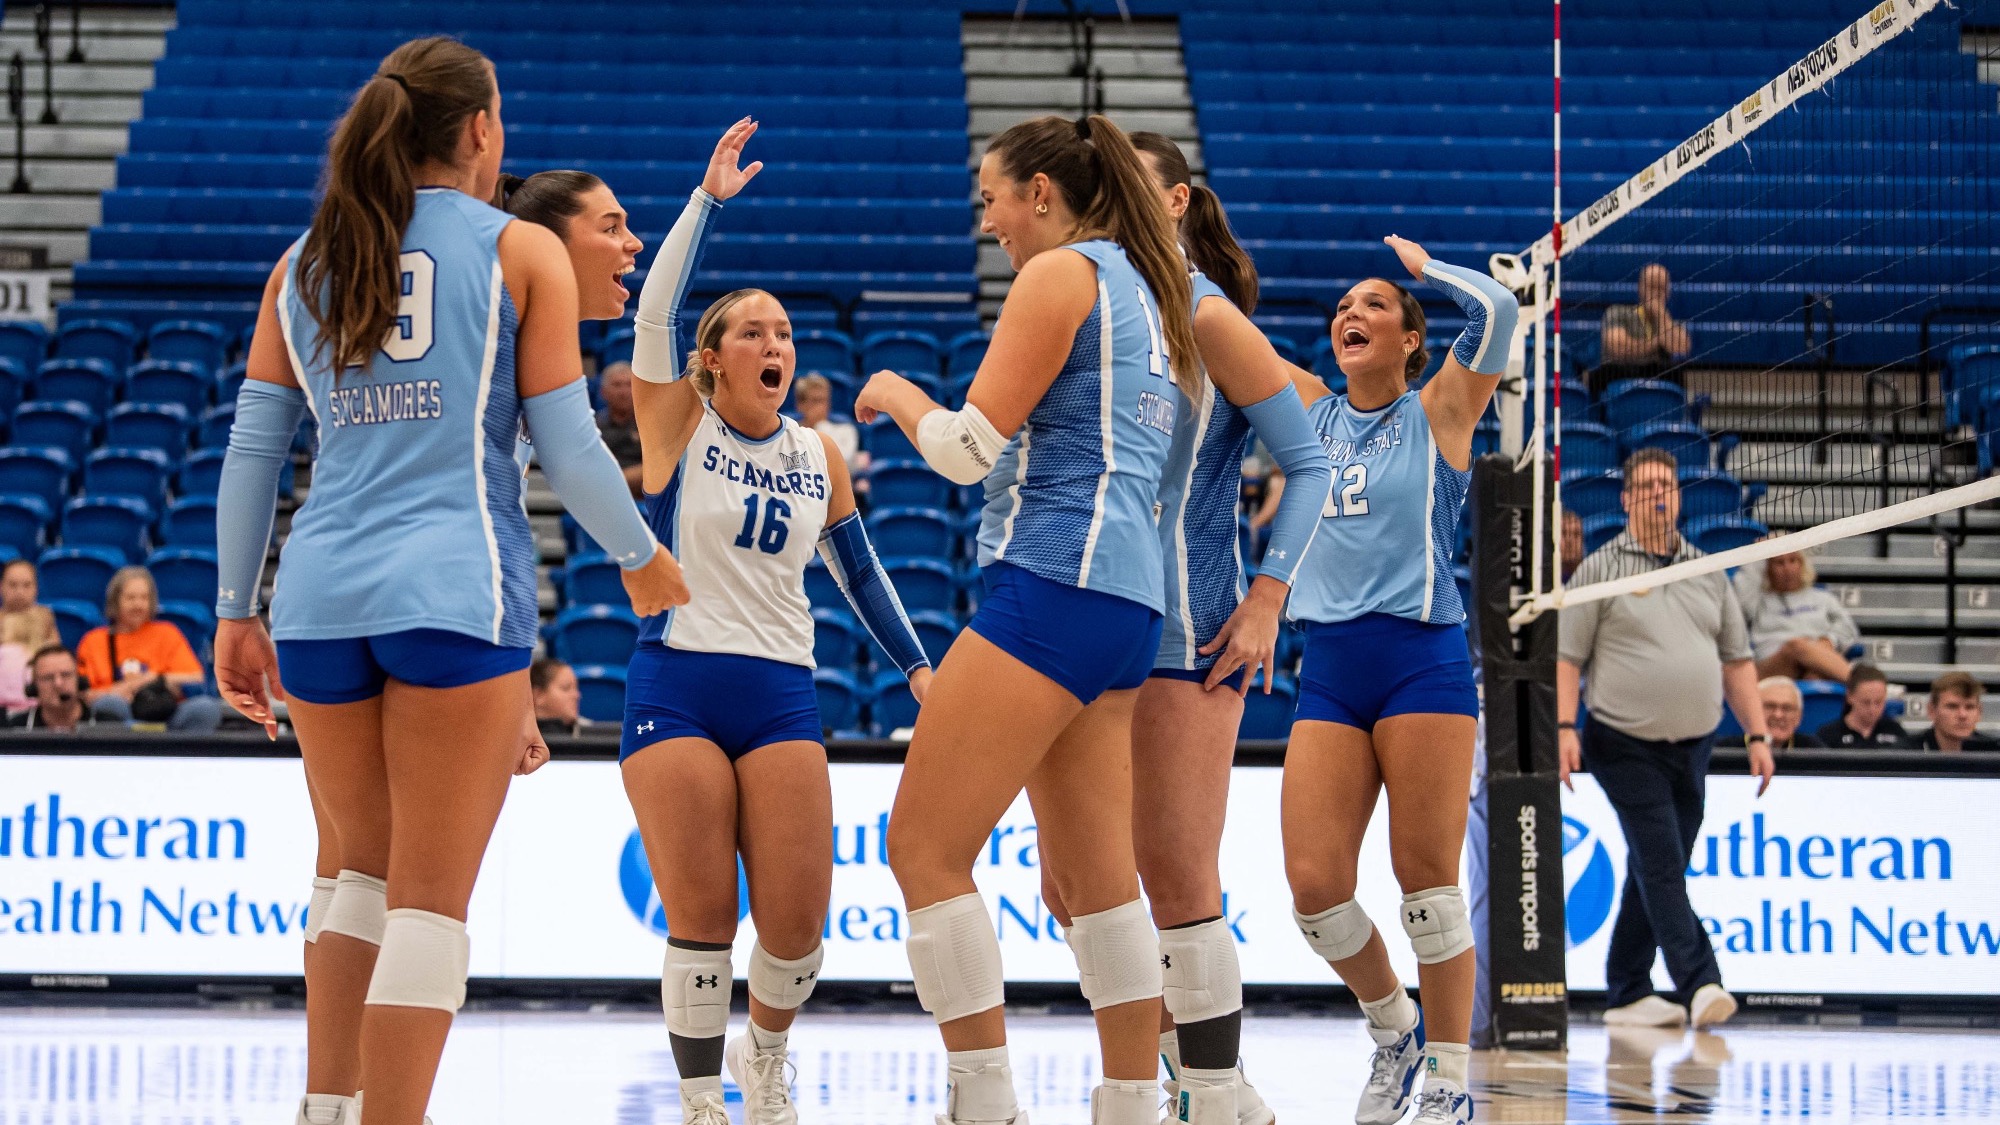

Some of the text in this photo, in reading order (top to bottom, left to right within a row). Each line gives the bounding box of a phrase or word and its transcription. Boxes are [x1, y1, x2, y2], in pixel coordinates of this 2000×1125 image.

[329, 379, 443, 429] SYCAMORES
[1322, 463, 1370, 518] 12
[734, 493, 791, 555] 16
[1685, 812, 1952, 880] utheran
[1517, 805, 1541, 951] sports imports
[141, 886, 308, 935] Netw
[1700, 900, 1832, 954] ealth
[1501, 983, 1565, 996] PURDUE
